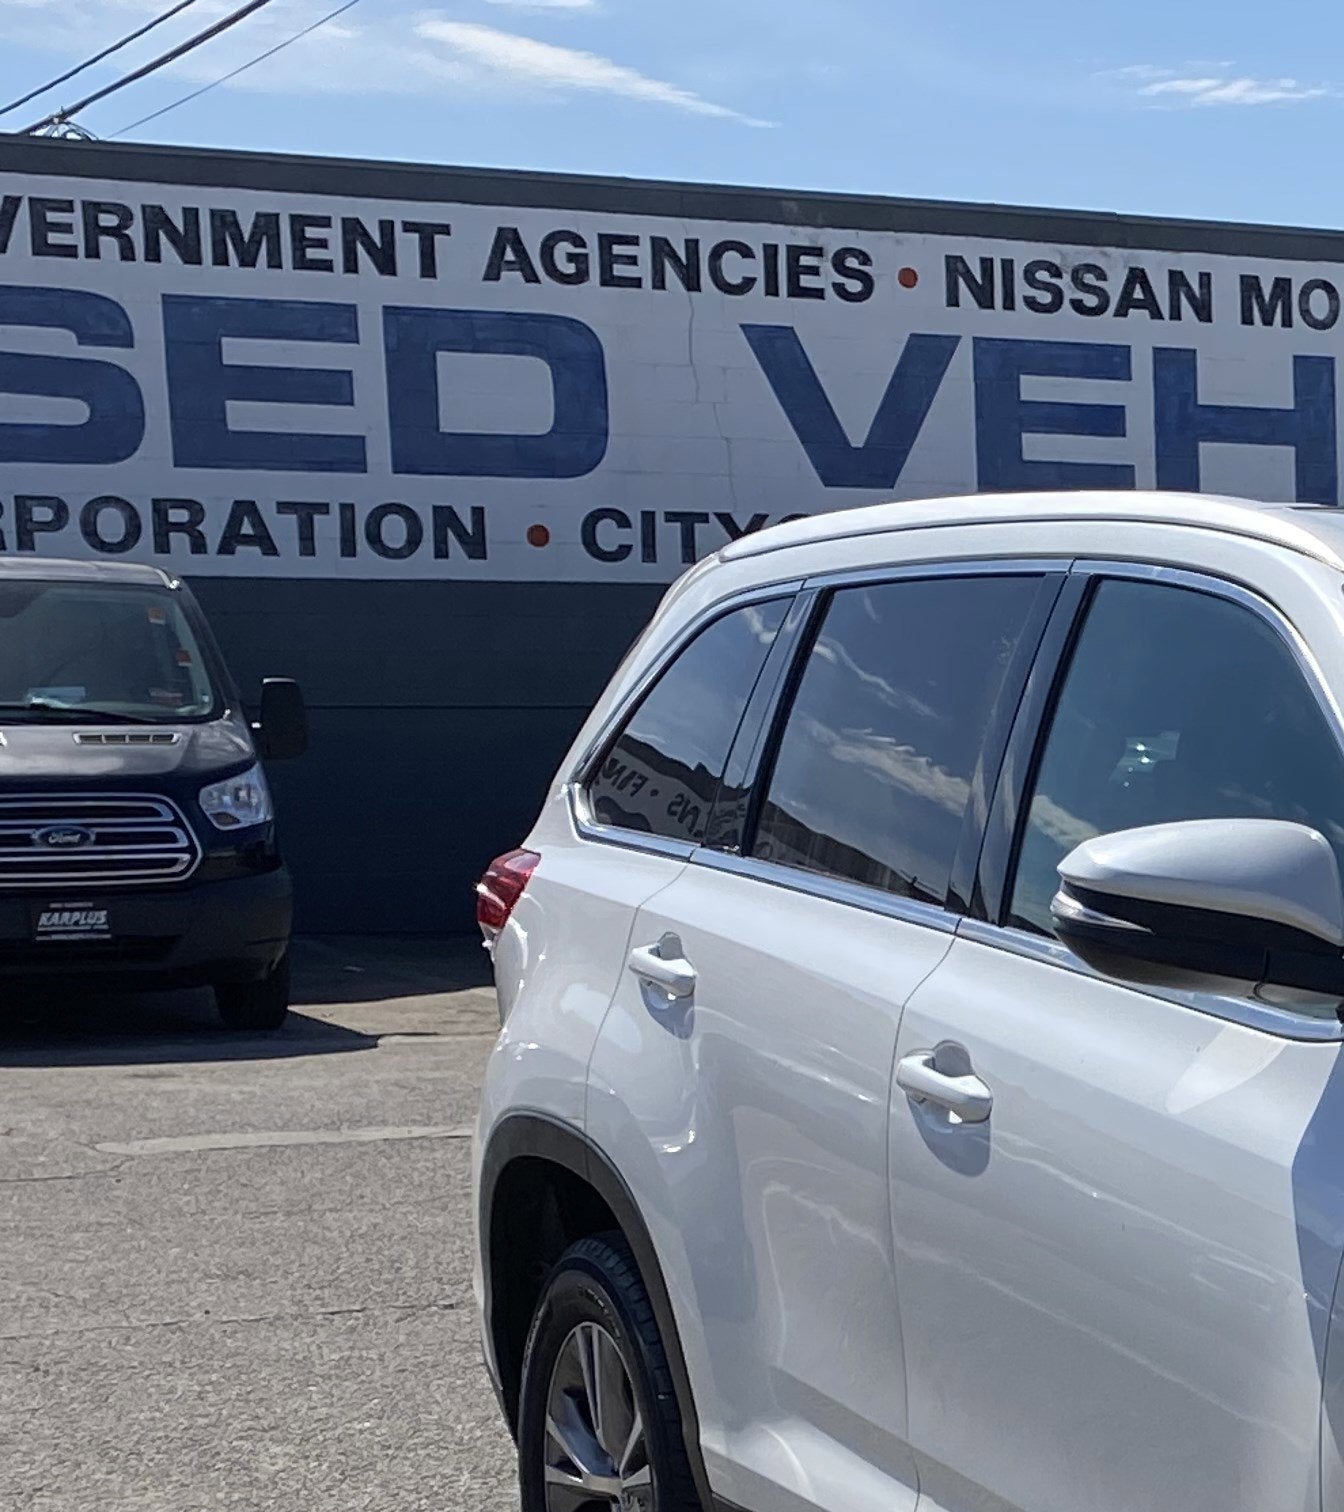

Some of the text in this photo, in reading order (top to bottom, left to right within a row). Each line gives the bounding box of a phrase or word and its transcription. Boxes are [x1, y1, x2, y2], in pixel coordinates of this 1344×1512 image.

[481, 226, 875, 303] AGENCIES
[944, 254, 1214, 324] NISSAN
[0, 284, 609, 479] SED
[0, 494, 488, 562] PORATION
[48, 832, 81, 844] Ford
[38, 910, 108, 926] KARPLUS
